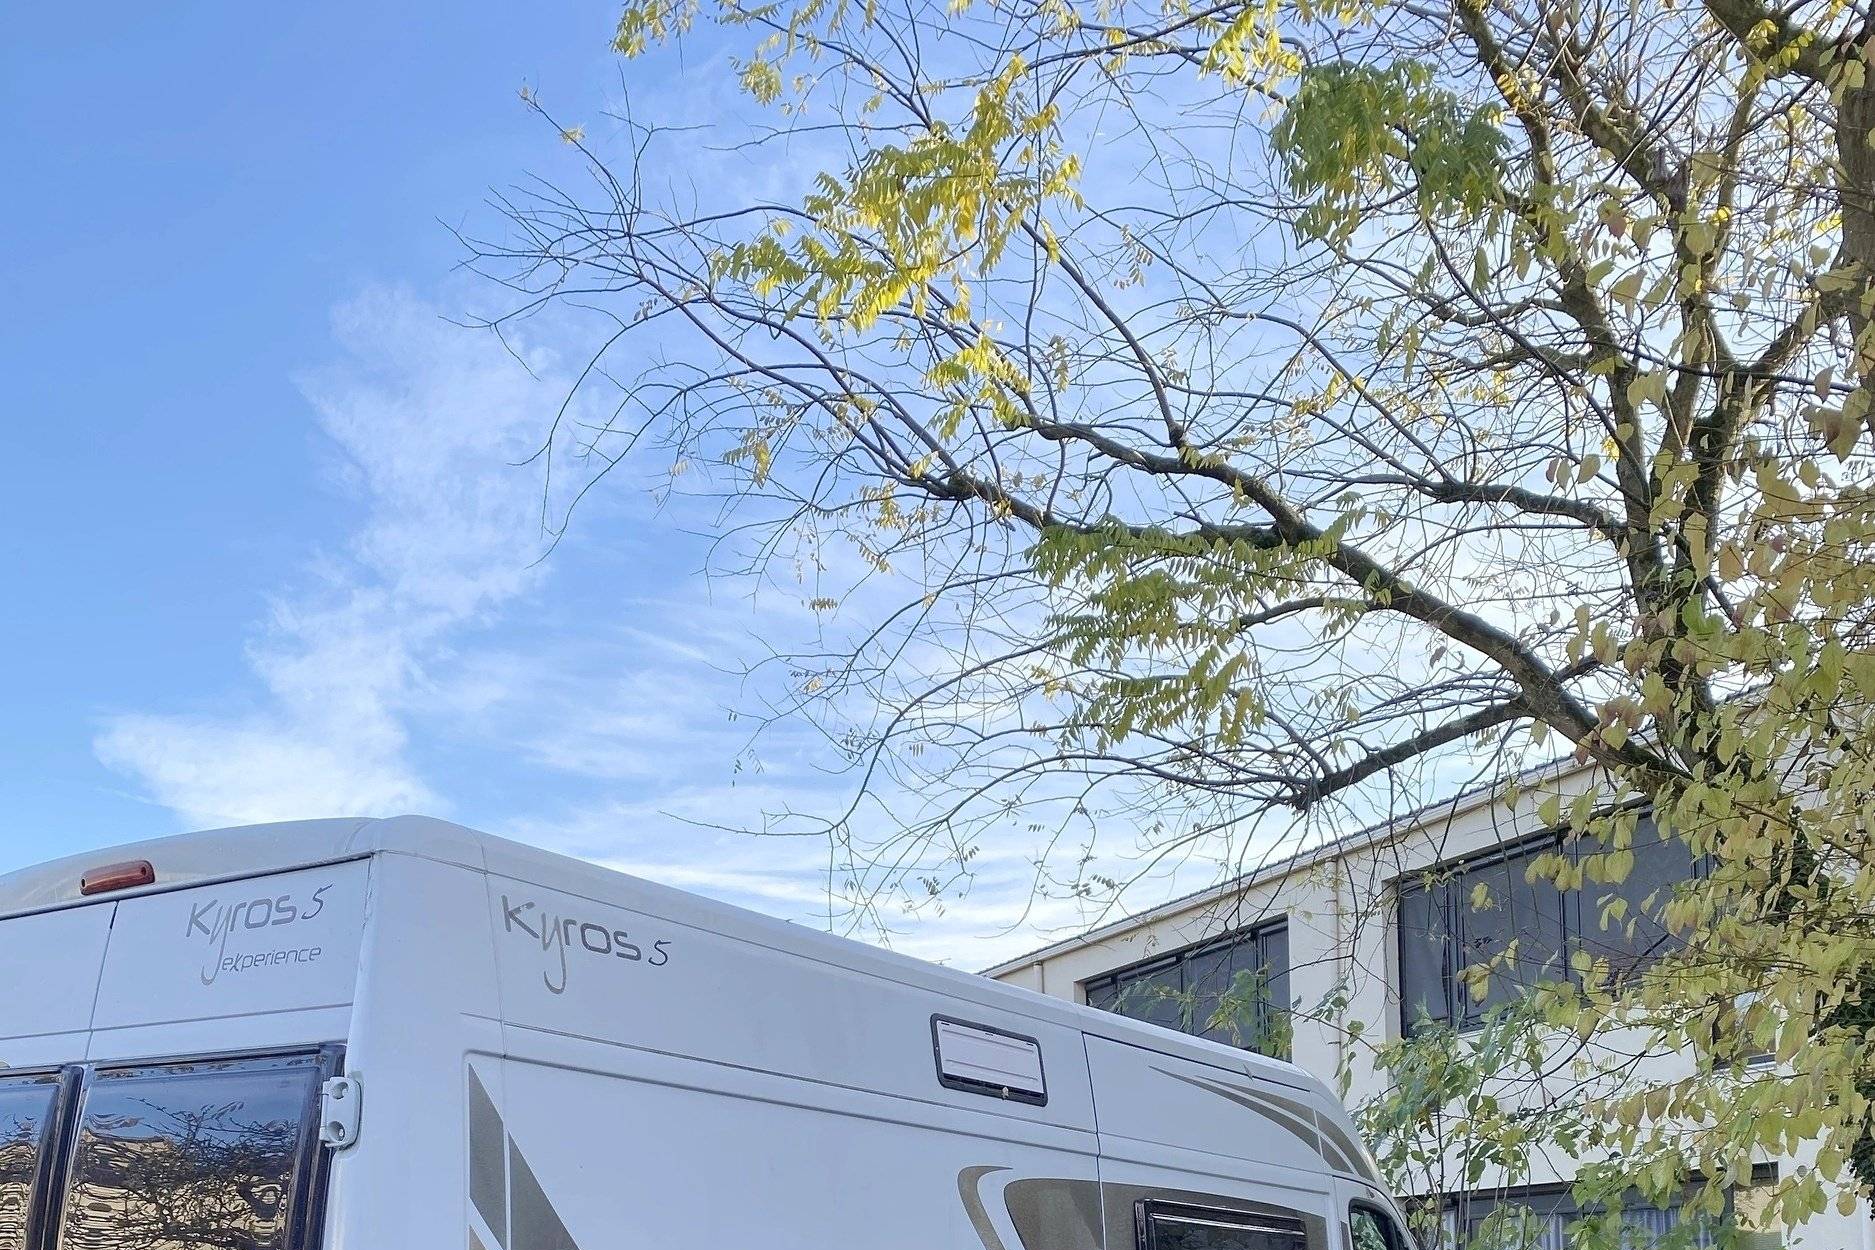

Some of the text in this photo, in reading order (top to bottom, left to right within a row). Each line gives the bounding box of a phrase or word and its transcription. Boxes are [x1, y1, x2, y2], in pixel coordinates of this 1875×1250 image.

[186, 884, 333, 985] Kyros 5
[221, 947, 322, 972] experience
[501, 894, 672, 994] Kyros 5
